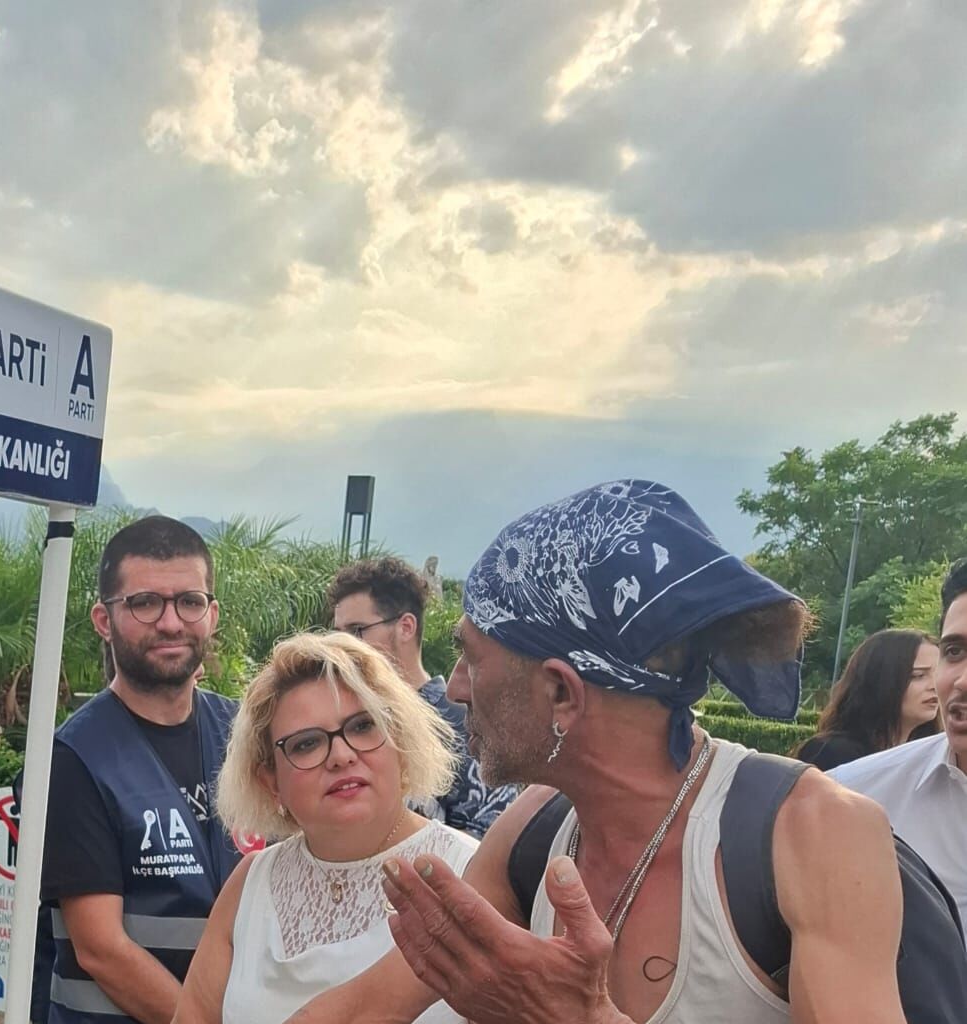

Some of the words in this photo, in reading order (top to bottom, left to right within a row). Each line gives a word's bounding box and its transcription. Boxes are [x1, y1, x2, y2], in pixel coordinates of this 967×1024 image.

[70, 334, 95, 400] A
[169, 808, 191, 838] A
[140, 853, 196, 866] MURATPAŞA
